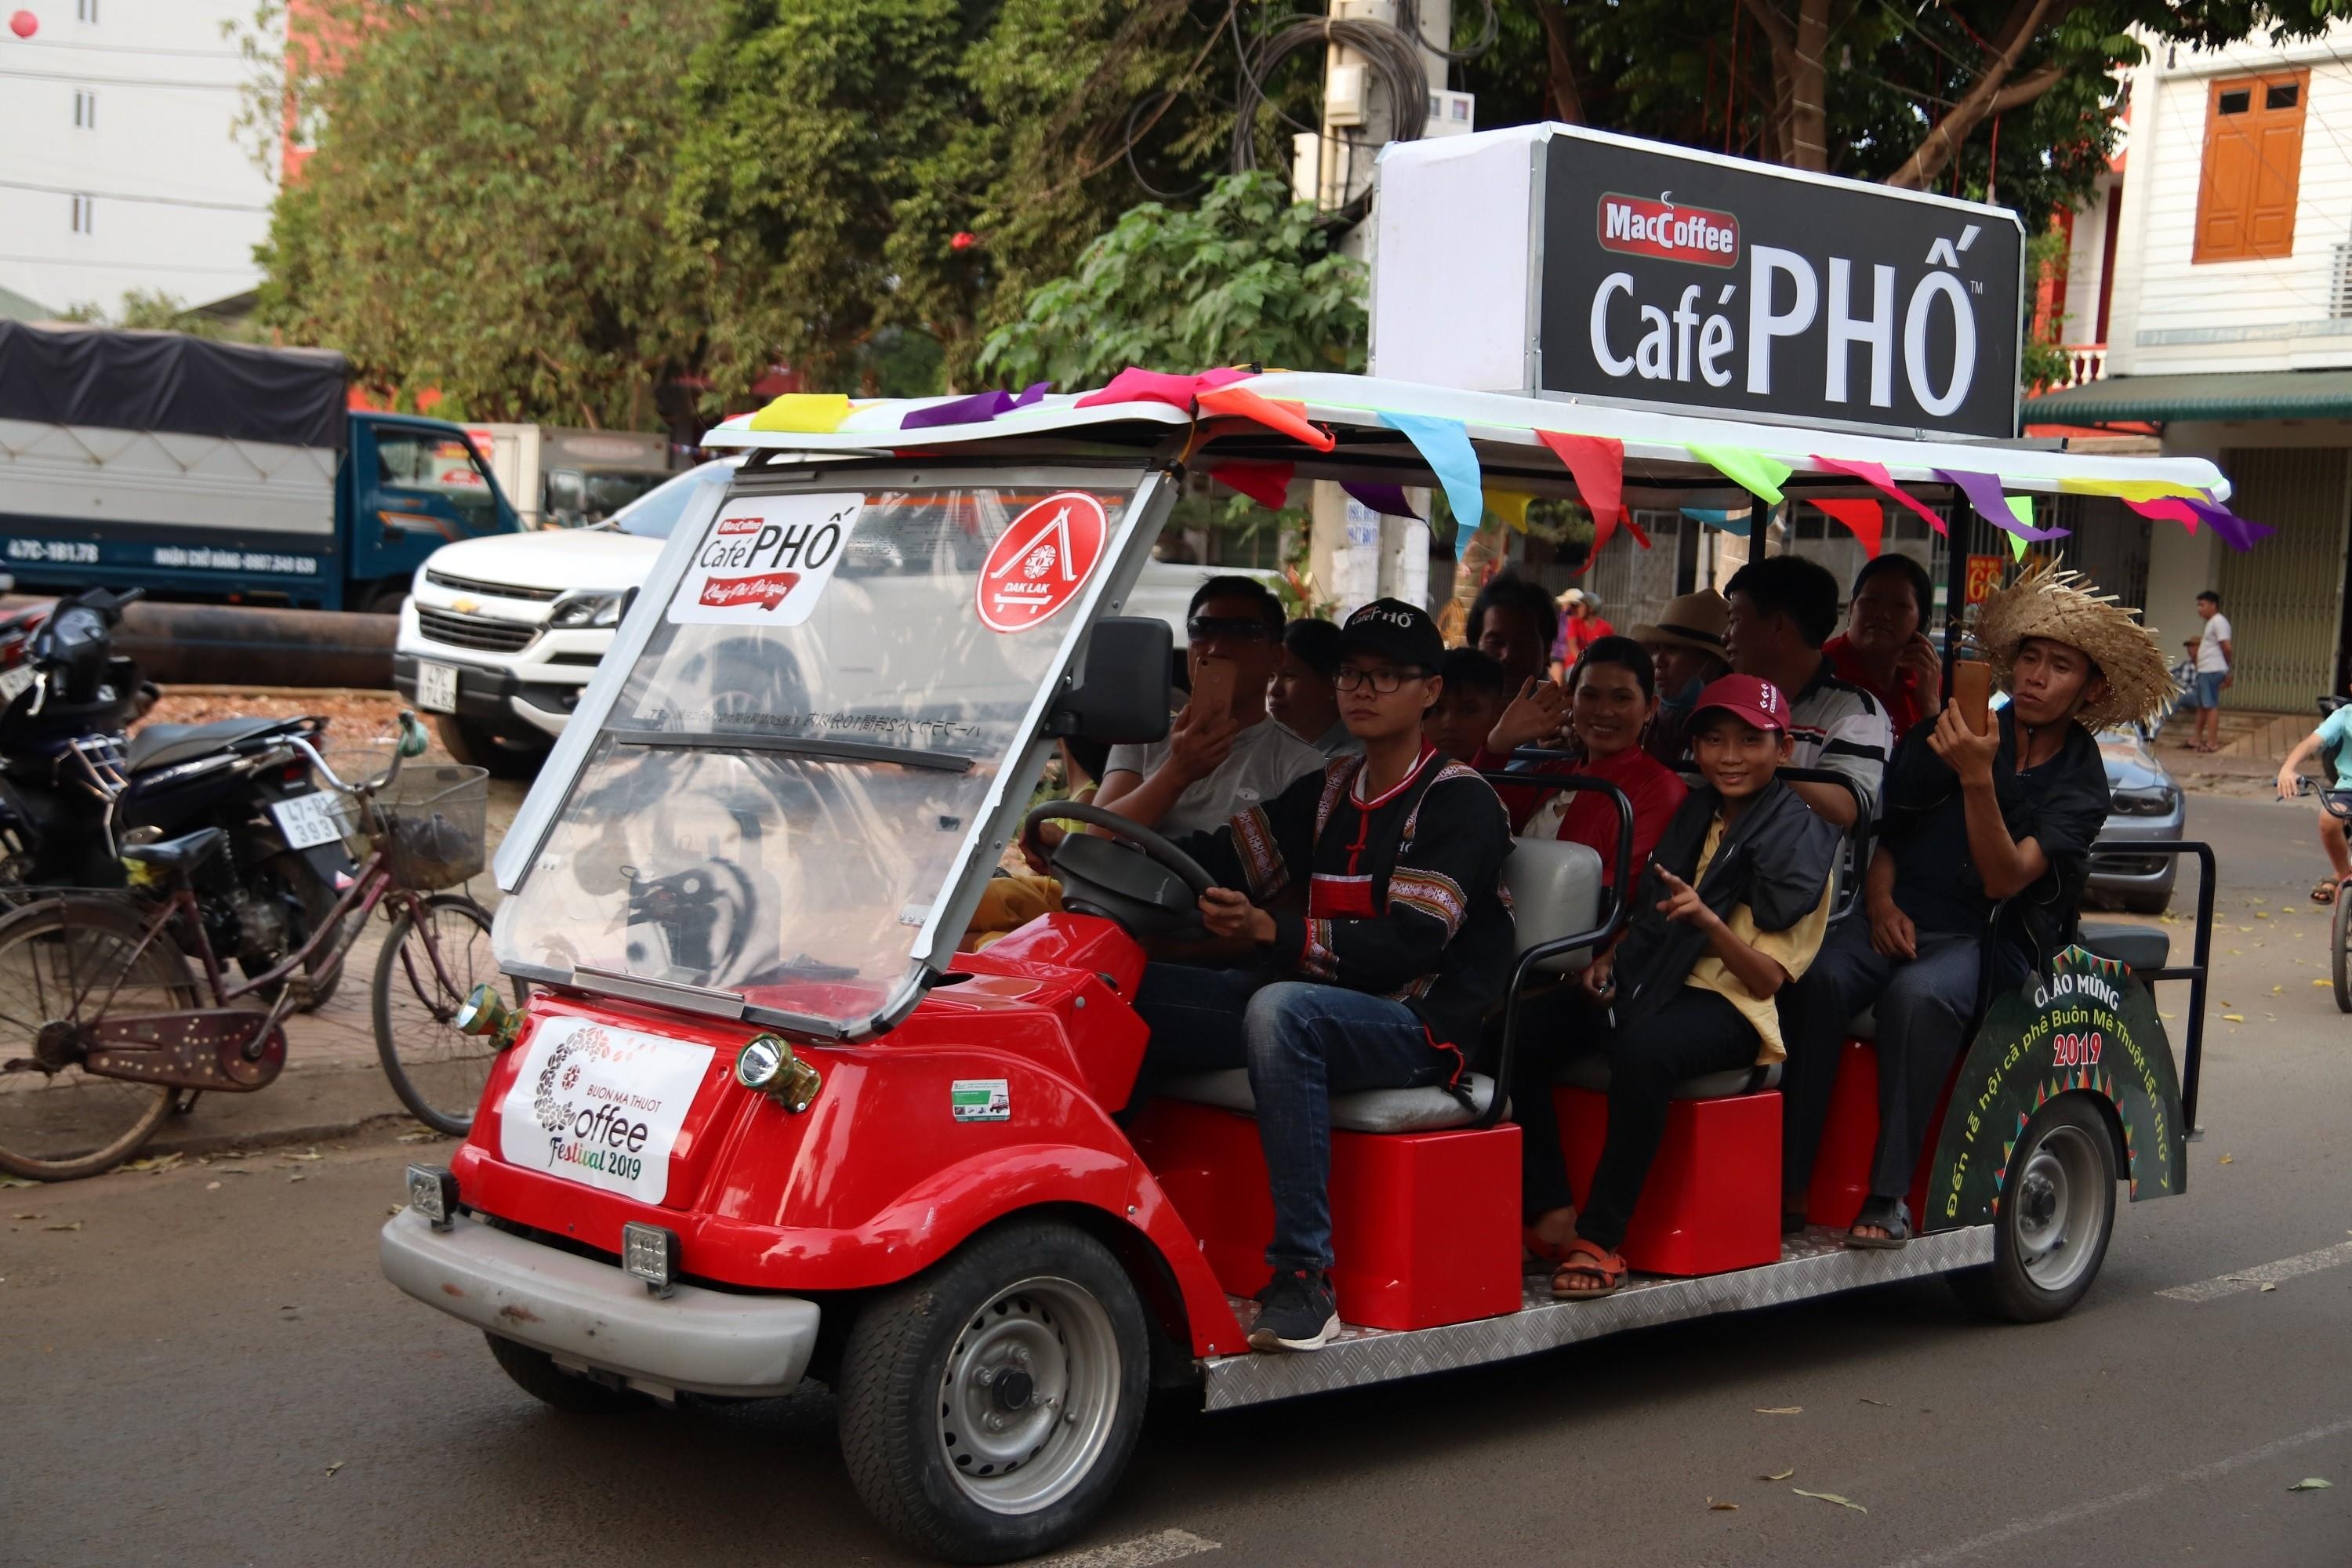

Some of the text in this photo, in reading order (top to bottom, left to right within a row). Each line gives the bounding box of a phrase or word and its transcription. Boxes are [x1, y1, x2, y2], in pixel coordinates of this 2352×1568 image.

[1606, 202, 1733, 254] MacCoffee
[1590, 272, 1736, 387] Café
[1747, 224, 1981, 417] PHỐ
[700, 506, 855, 570] Café PHỐ
[720, 520, 762, 533] MacCoffee
[1004, 582, 1051, 594] DAK LAK
[1978, 1067, 2002, 1110] hội
[2003, 1043, 2020, 1070] cà
[2022, 1014, 2049, 1053] phê
[2052, 1004, 2089, 1029] Buôn
[2093, 1008, 2114, 1033] Mê
[2117, 1021, 2145, 1073] Thuột
[2053, 1031, 2102, 1067] 2019
[586, 1084, 662, 1113] BUON MA THUOT
[548, 1136, 642, 1181] Festival 2019
